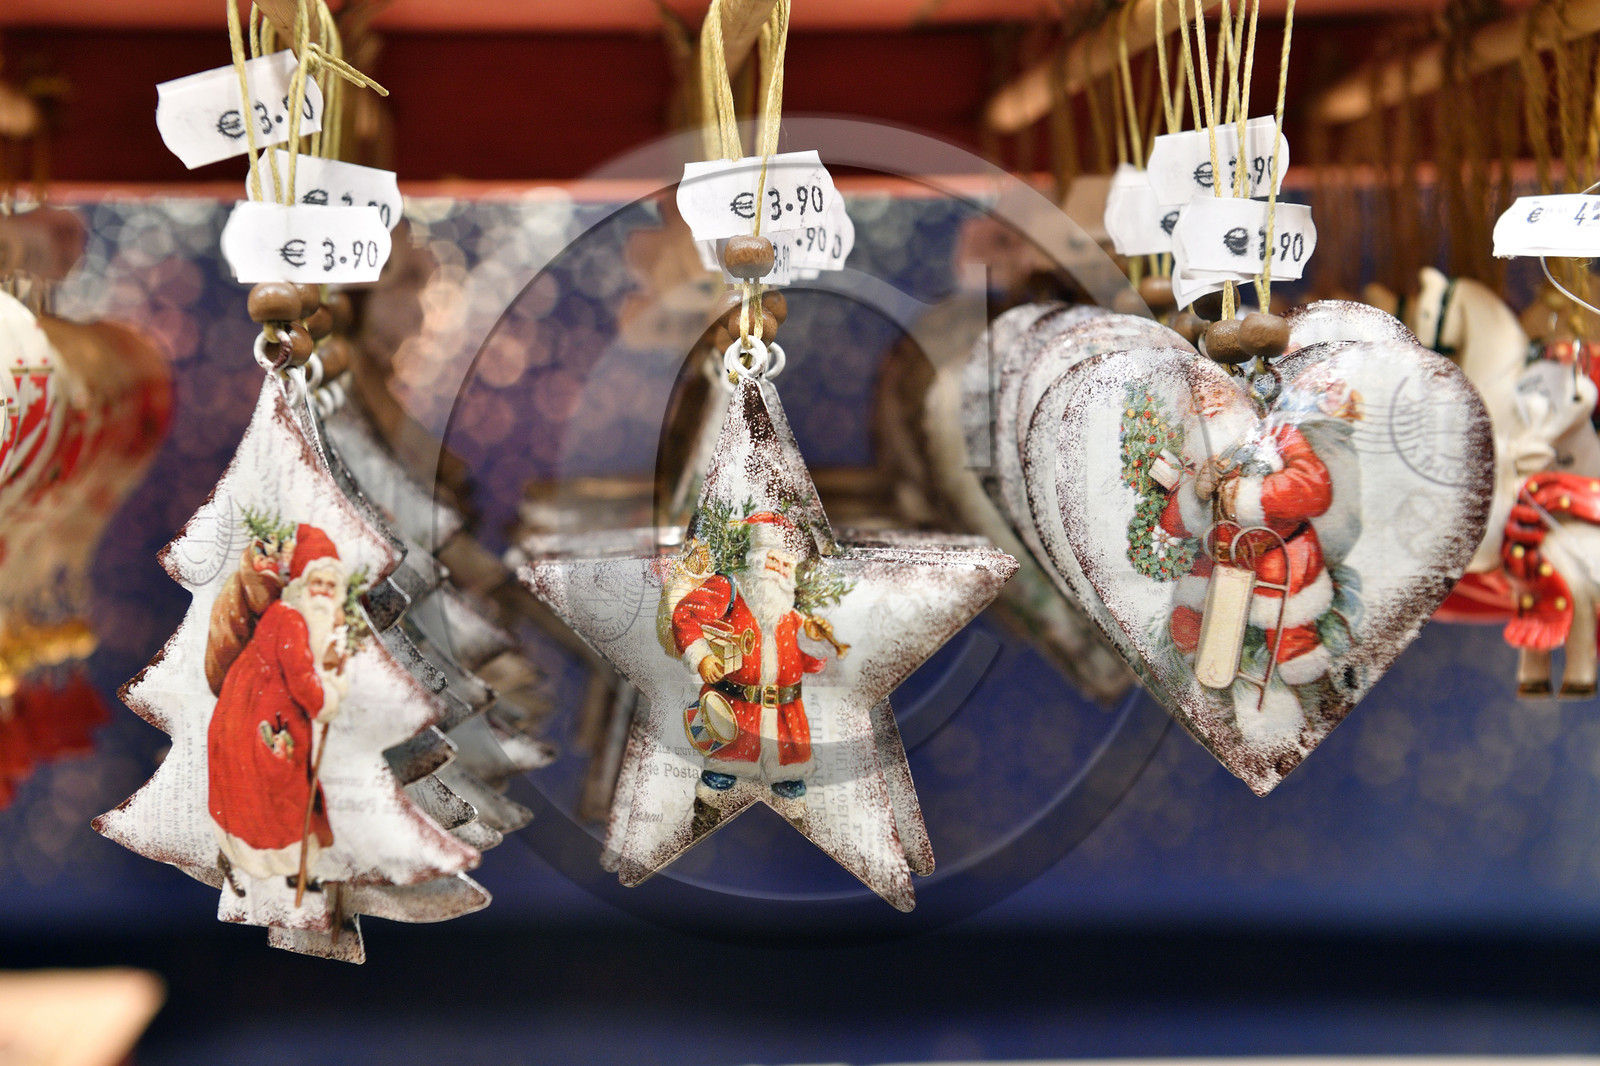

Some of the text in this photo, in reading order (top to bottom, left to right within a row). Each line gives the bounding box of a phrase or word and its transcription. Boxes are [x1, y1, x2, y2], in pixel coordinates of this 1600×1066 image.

[254, 94, 314, 135] 3.0
[730, 185, 824, 221] € 3.90
[280, 237, 379, 272] € 3.90
